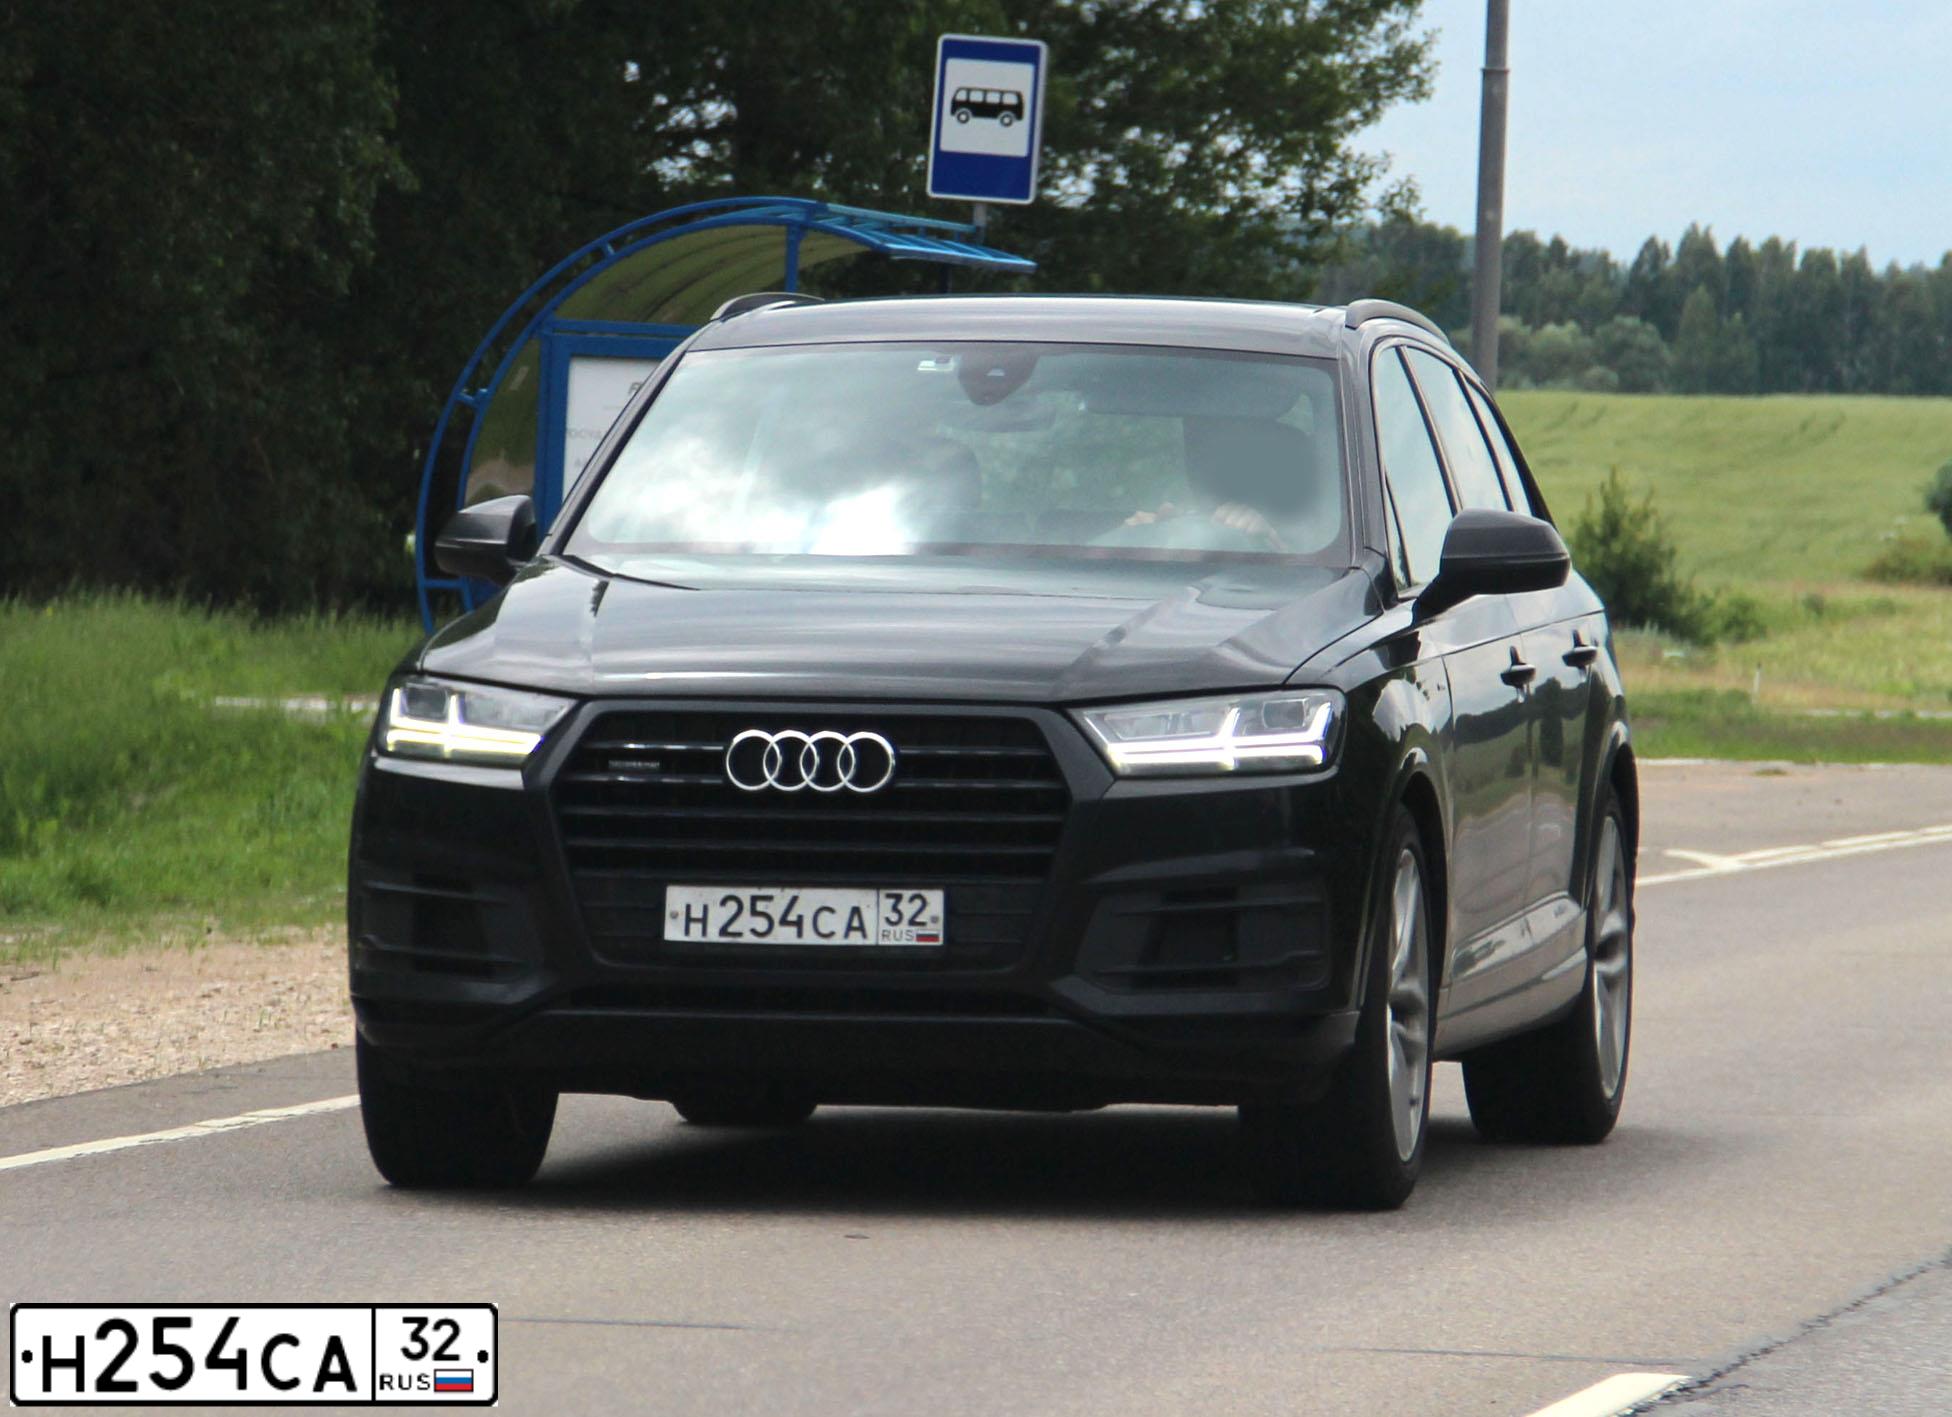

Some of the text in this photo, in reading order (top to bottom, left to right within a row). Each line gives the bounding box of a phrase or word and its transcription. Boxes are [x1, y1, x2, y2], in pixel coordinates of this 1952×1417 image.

[684, 893, 928, 939] H254CA 32
[881, 930, 914, 942] RUS
